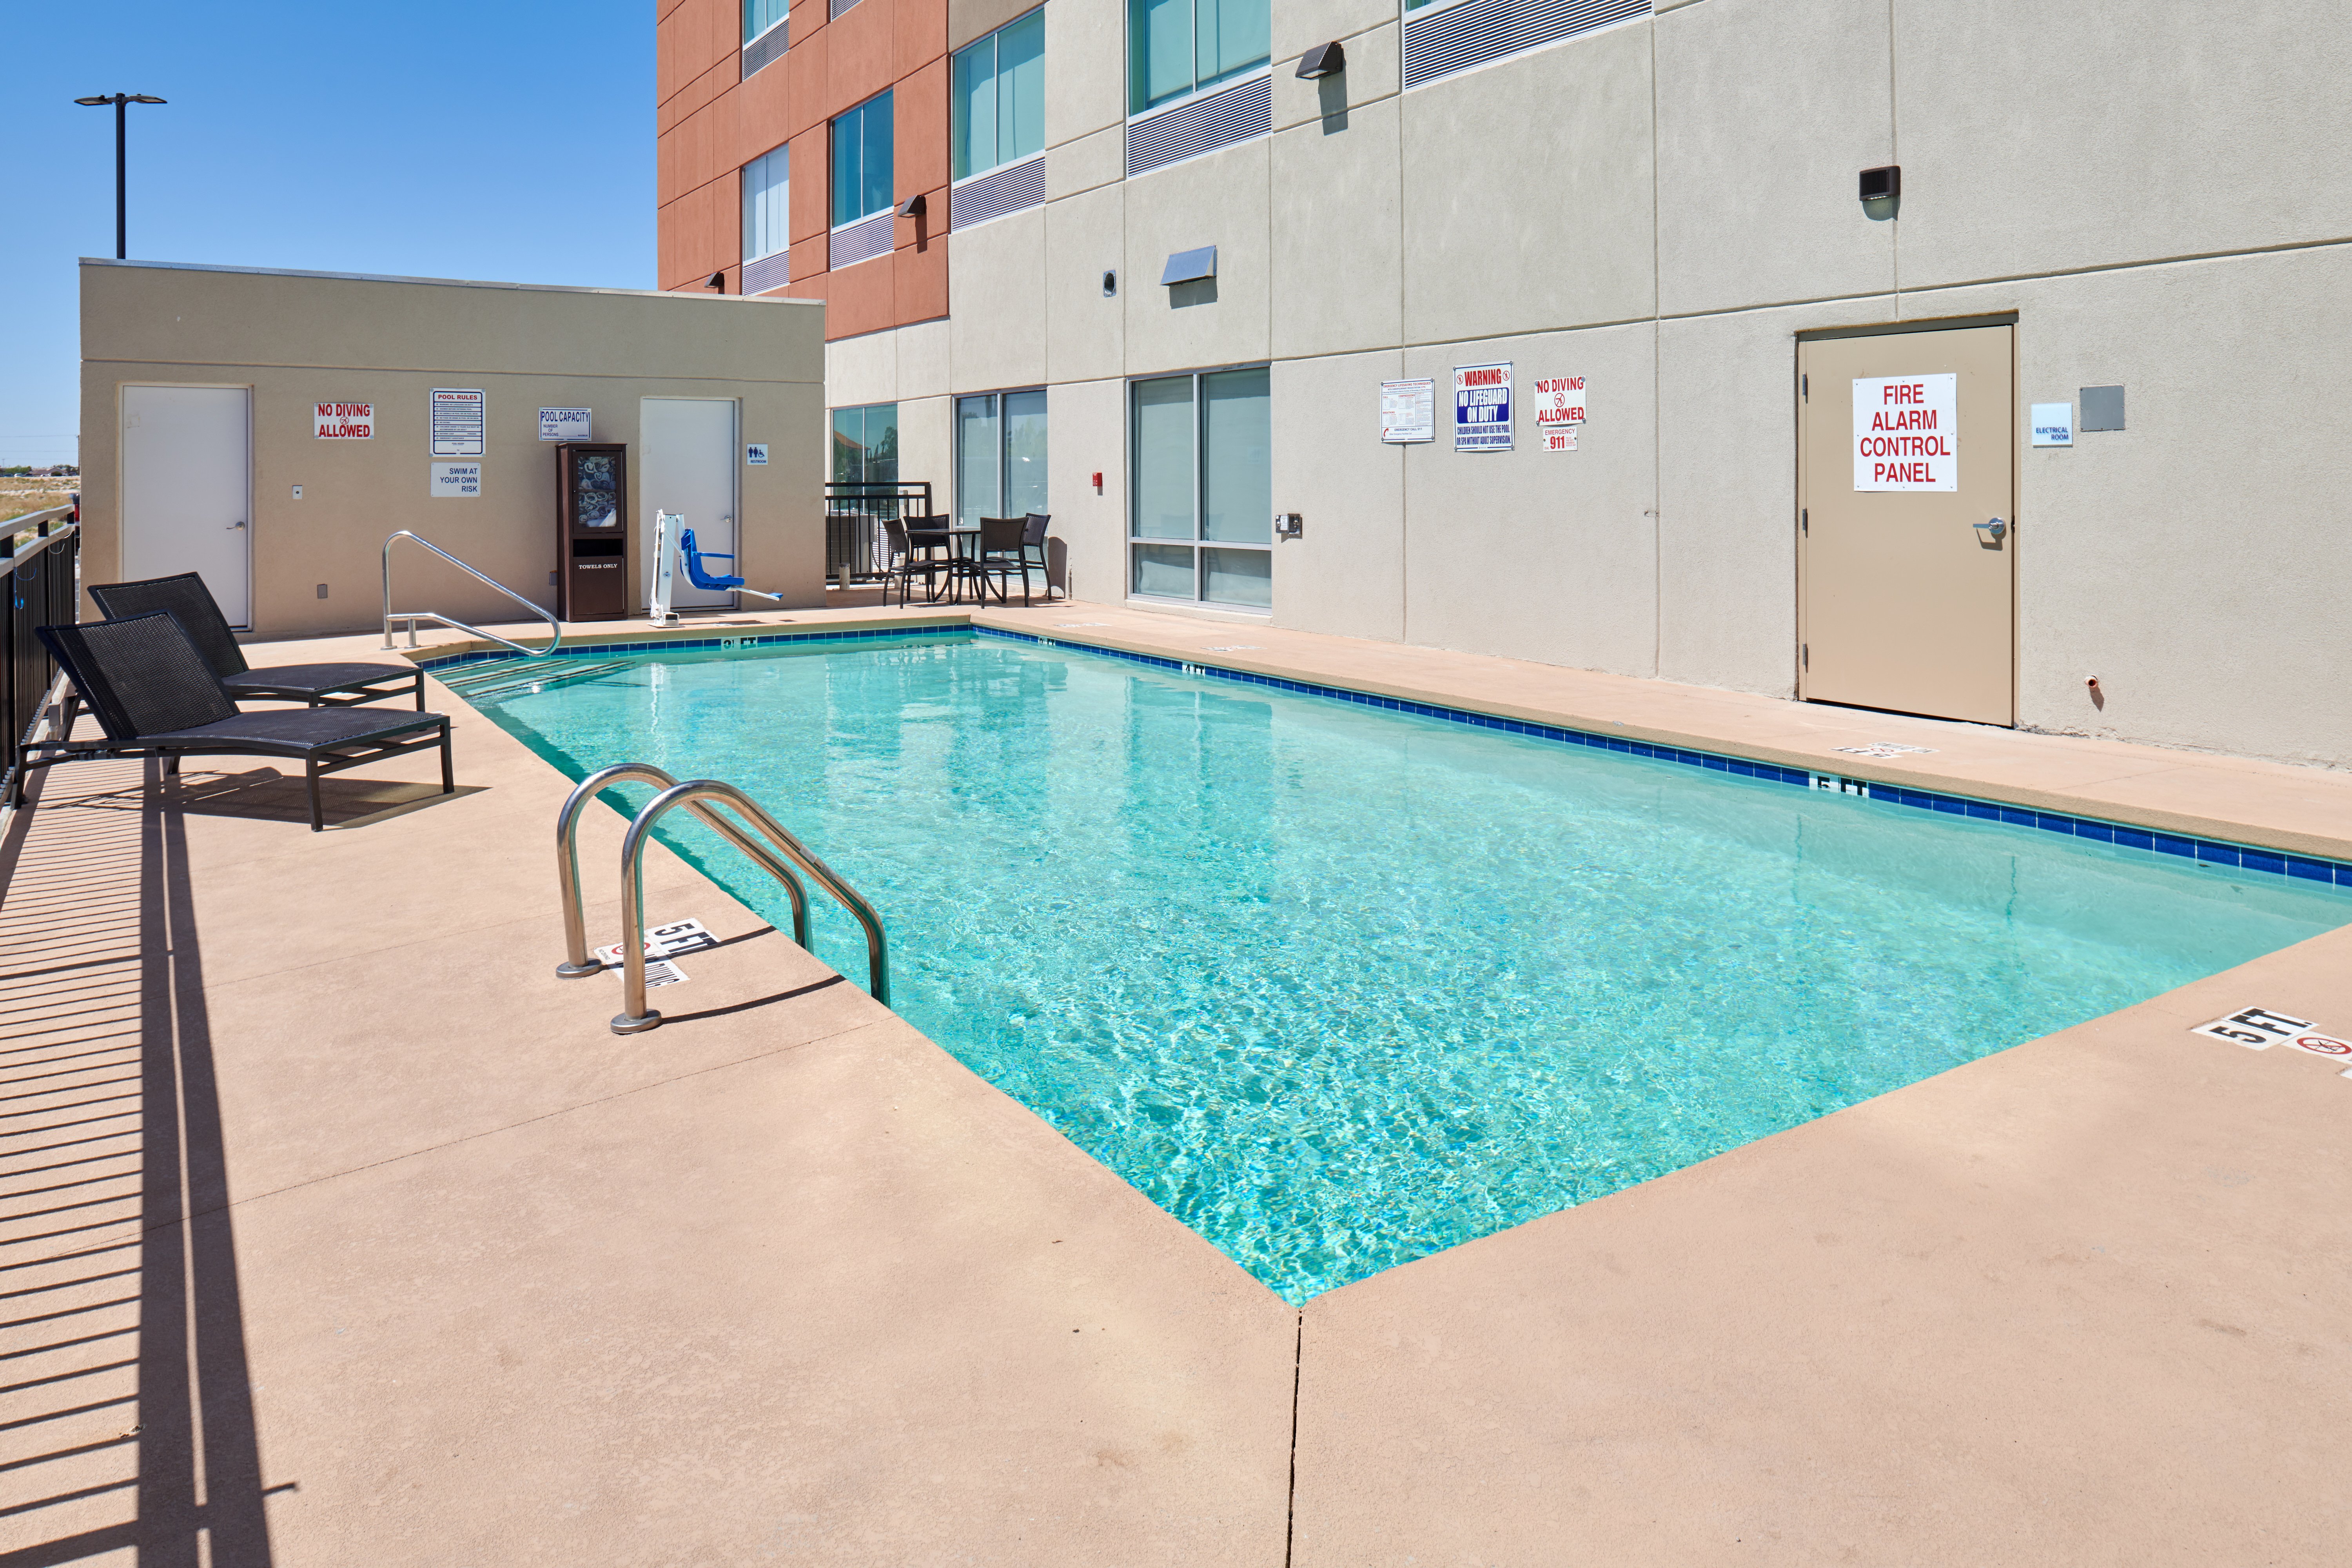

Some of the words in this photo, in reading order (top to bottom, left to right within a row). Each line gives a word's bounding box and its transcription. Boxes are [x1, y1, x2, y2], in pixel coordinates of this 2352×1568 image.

[1465, 368, 1501, 387] WARNING
[1537, 380, 1549, 393] NO
[1552, 377, 1583, 392] DIVING
[1459, 391, 1468, 407] NO
[1470, 388, 1507, 406] LIFEGUARD
[1884, 384, 1924, 405] FIRE
[318, 404, 332, 416] NO
[336, 404, 370, 416] DIVING
[541, 411, 558, 422] POOL
[559, 412, 589, 422] CAPACITY
[1467, 407, 1477, 423] ON
[1479, 405, 1498, 422] DUTY
[1539, 407, 1584, 422] ALLOWED
[1872, 410, 1936, 431] ALARM
[319, 425, 370, 437] ALLOWED
[1457, 426, 1470, 435] CHILDREN
[1471, 426, 1482, 434] SHOULD
[1457, 437, 1461, 445] OR
[1467, 436, 1479, 445] WITHOUT
[1481, 436, 1489, 444] ADULT
[1490, 435, 1511, 444] SUPERVISION.
[1550, 436, 1564, 449] 911
[1860, 436, 1950, 457] CONTROL
[1875, 463, 1936, 482] PANEL
[654, 923, 695, 936] 5
[2209, 1026, 2267, 1043] 5
